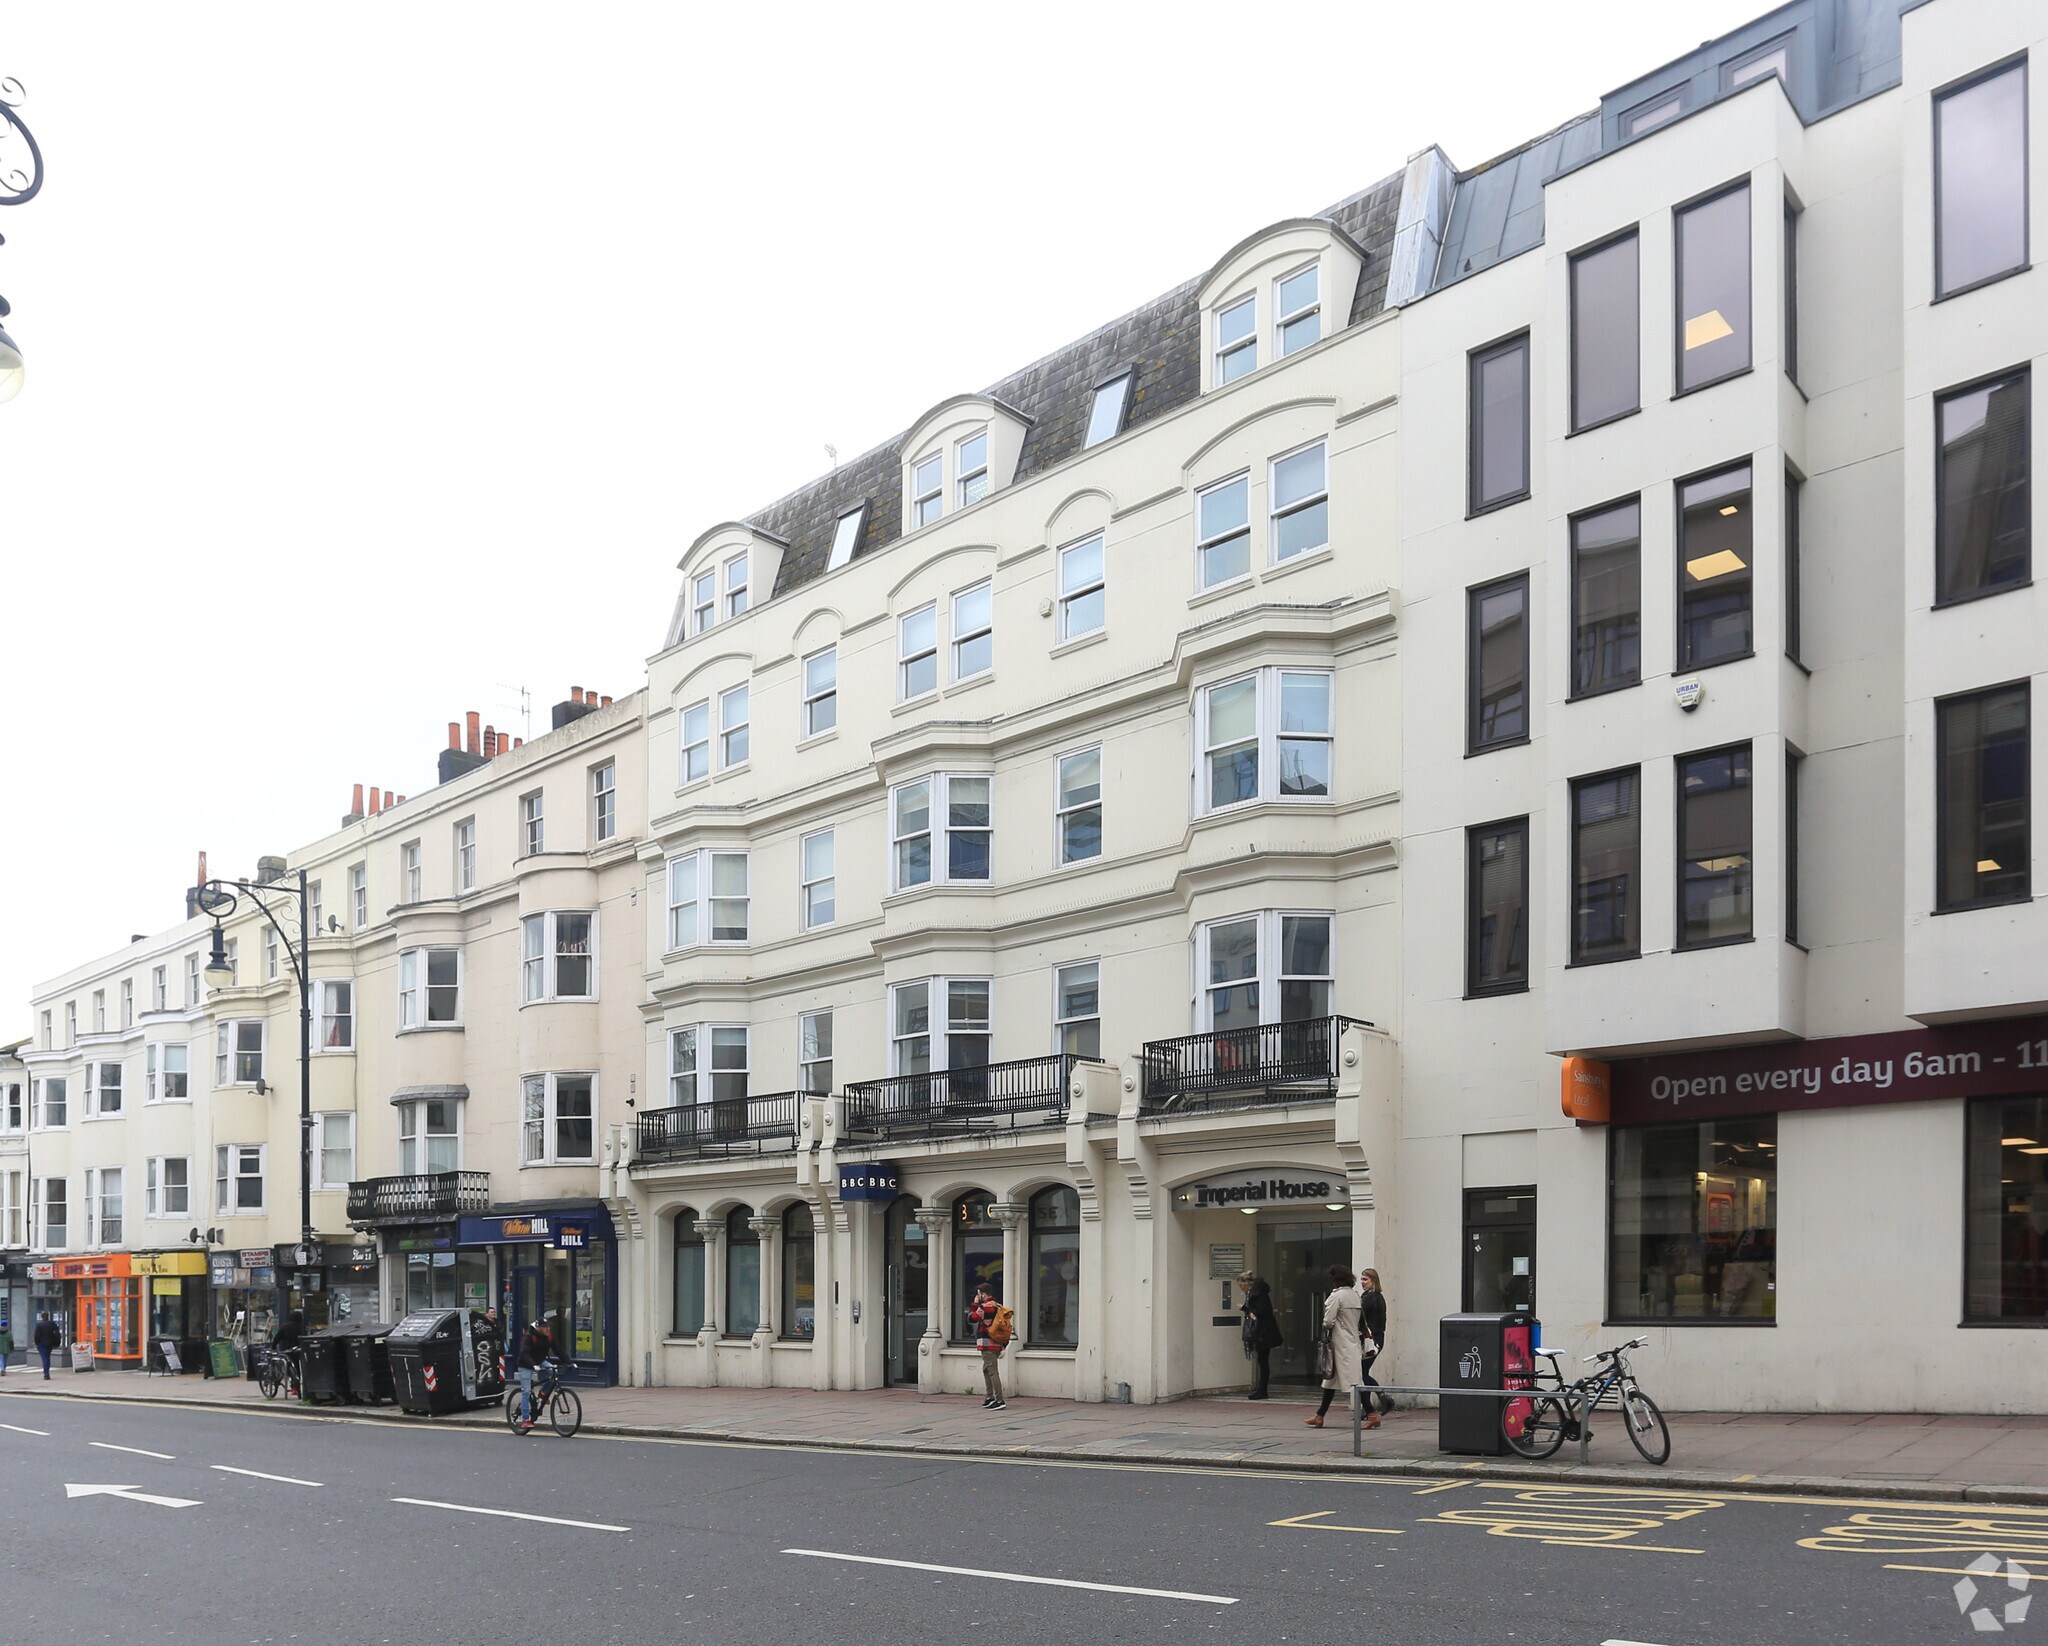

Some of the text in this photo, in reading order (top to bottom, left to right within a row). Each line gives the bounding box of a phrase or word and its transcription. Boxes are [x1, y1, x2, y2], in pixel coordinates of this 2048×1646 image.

[1676, 683, 1699, 694] URBAN
[1651, 1075, 1727, 1104] Open
[1735, 1067, 1822, 1094] every
[1830, 1057, 1894, 1088] day
[1903, 1051, 1981, 1078] 6am
[841, 1178, 864, 1188] BBC
[869, 1177, 897, 1188] BBC
[1269, 1179, 1330, 1199] House
[531, 1218, 549, 1234] HILL
[561, 1235, 583, 1246] HILL
